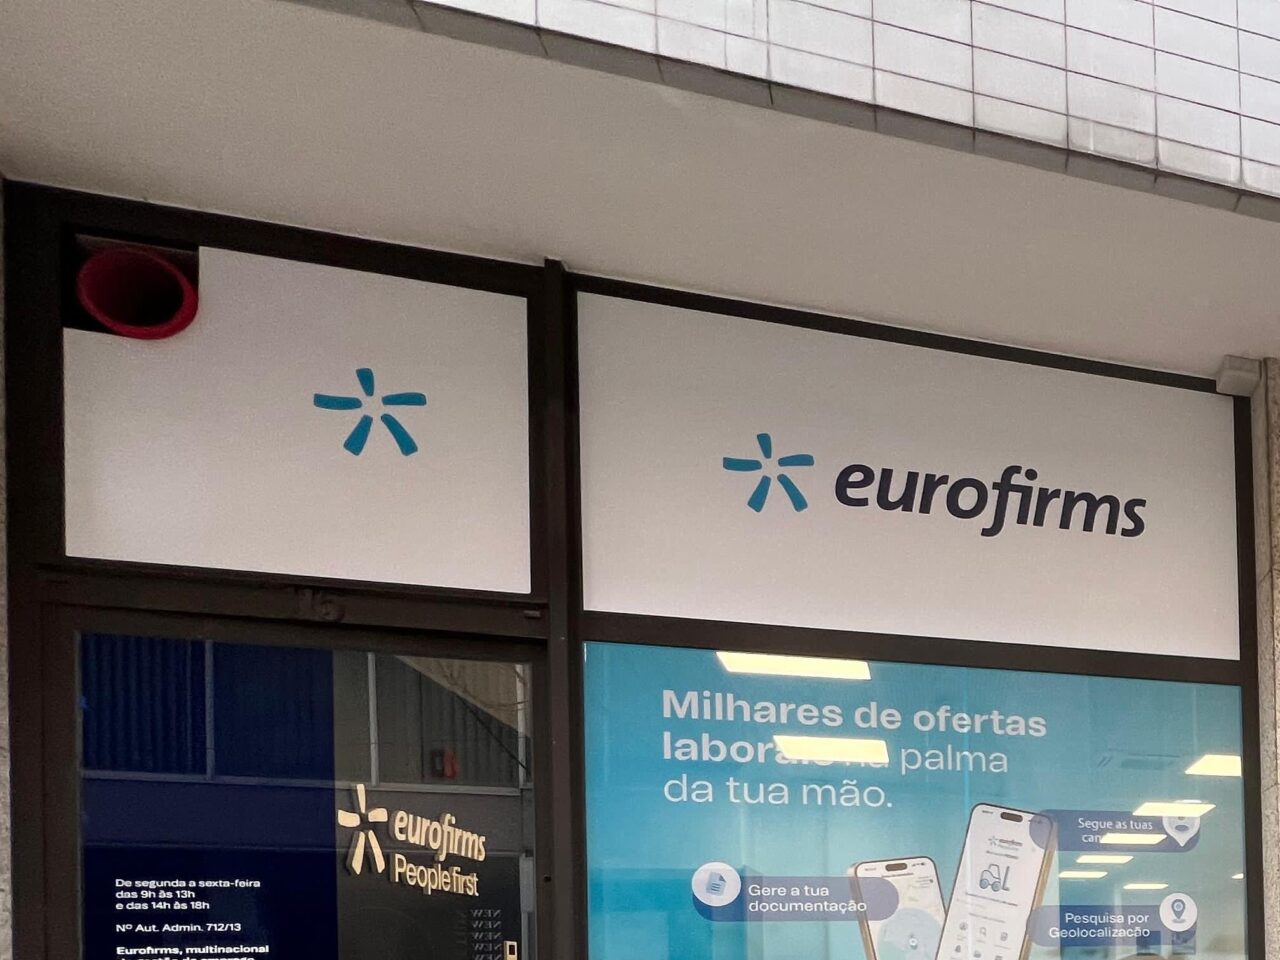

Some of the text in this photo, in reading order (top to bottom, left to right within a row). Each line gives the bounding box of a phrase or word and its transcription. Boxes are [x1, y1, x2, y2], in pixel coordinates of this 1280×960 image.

[834, 462, 1146, 537] eurofirms
[662, 689, 1047, 737] Milhares de ofertas
[663, 731, 834, 766] labor
[901, 744, 1008, 775] palma
[664, 774, 892, 807] da tua mão.
[1078, 818, 1153, 831] Segue as tuas
[394, 810, 486, 861] eurofirms
[395, 853, 479, 896] People first
[115, 879, 132, 887] De
[135, 879, 186, 888] segunda
[199, 879, 260, 887] sexta-feira
[748, 884, 829, 896] Gere a tua
[116, 890, 195, 898] das 9h às 13h
[749, 900, 866, 914] documentação
[1065, 913, 1150, 925] Pesquisa por
[135, 924, 159, 932] Aut.
[162, 924, 204, 932] Admin.
[206, 923, 241, 932] 712/13
[116, 945, 269, 955] Eurofirms, multinacional
